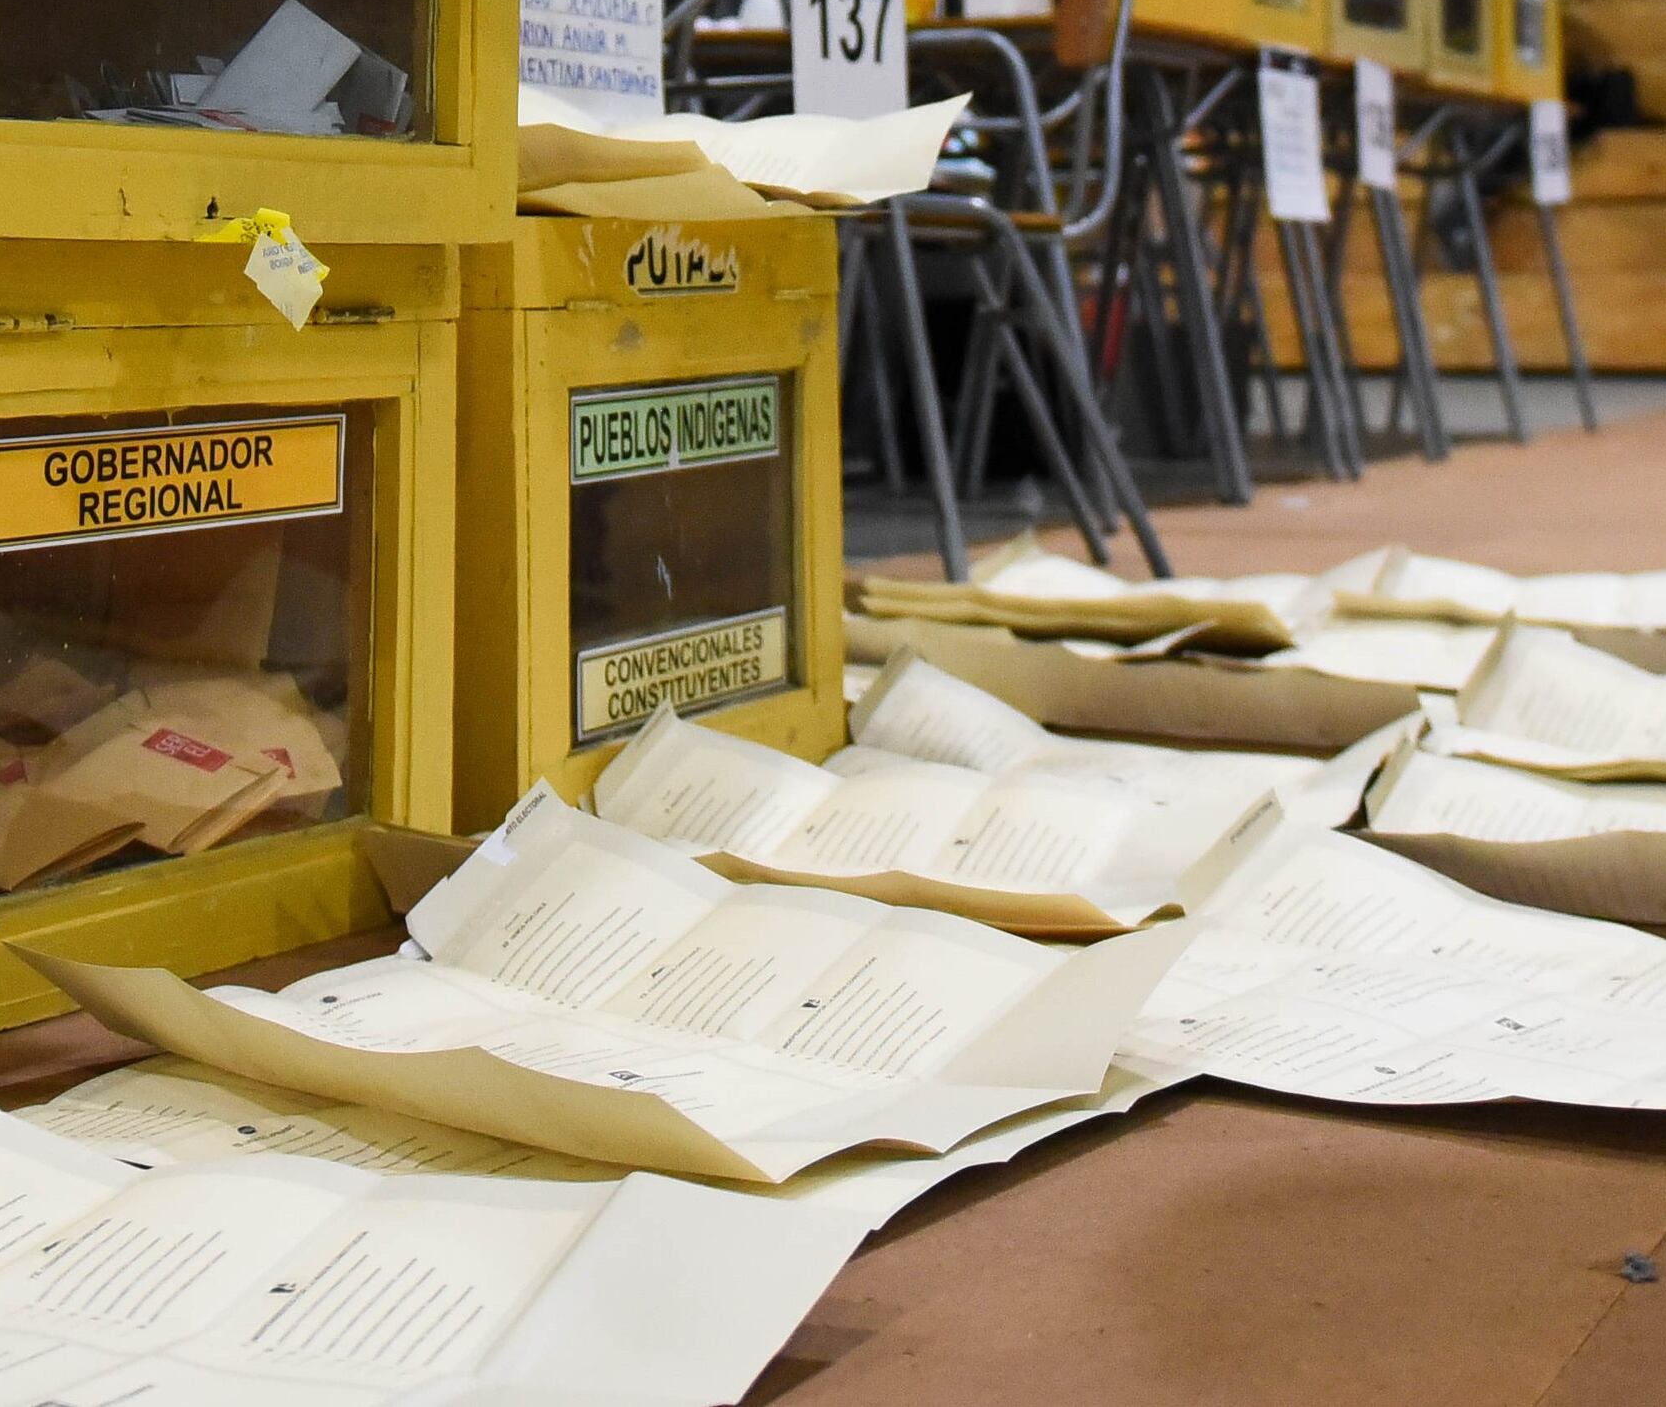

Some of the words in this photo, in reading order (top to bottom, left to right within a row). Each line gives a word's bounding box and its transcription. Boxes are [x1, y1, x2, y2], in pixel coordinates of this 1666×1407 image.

[44, 436, 273, 487] GOBERNADOR
[579, 405, 672, 468] PUEBLOS
[78, 479, 243, 527] REGIONAL
[604, 625, 764, 687] CONVENCIONALES
[607, 656, 762, 721] CONSTITUYENTES
